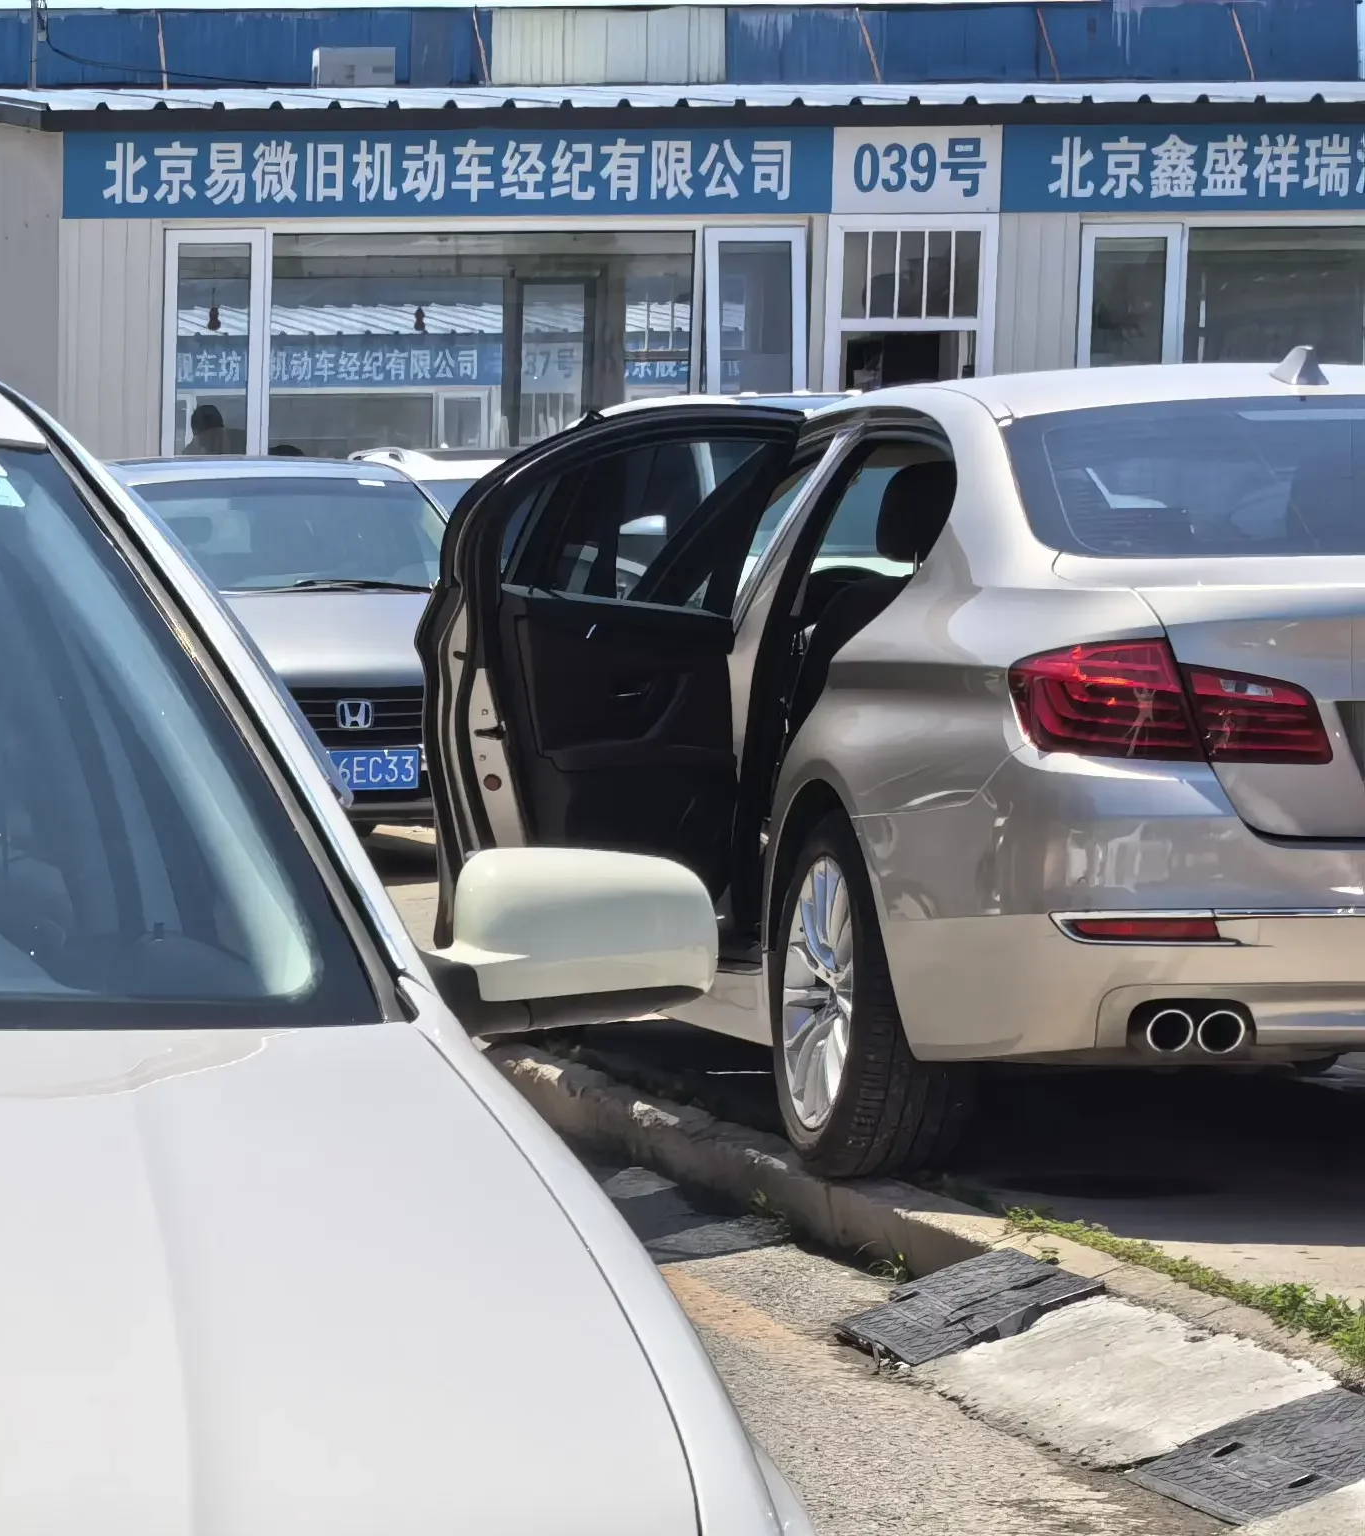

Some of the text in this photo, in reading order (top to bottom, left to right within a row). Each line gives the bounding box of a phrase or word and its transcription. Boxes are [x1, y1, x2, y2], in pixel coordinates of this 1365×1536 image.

[102, 138, 792, 205] 北京易微旧机动车经纪有限公司
[853, 137, 988, 198] 039号
[1048, 132, 1365, 199] 北京鑫盛祥瑞
